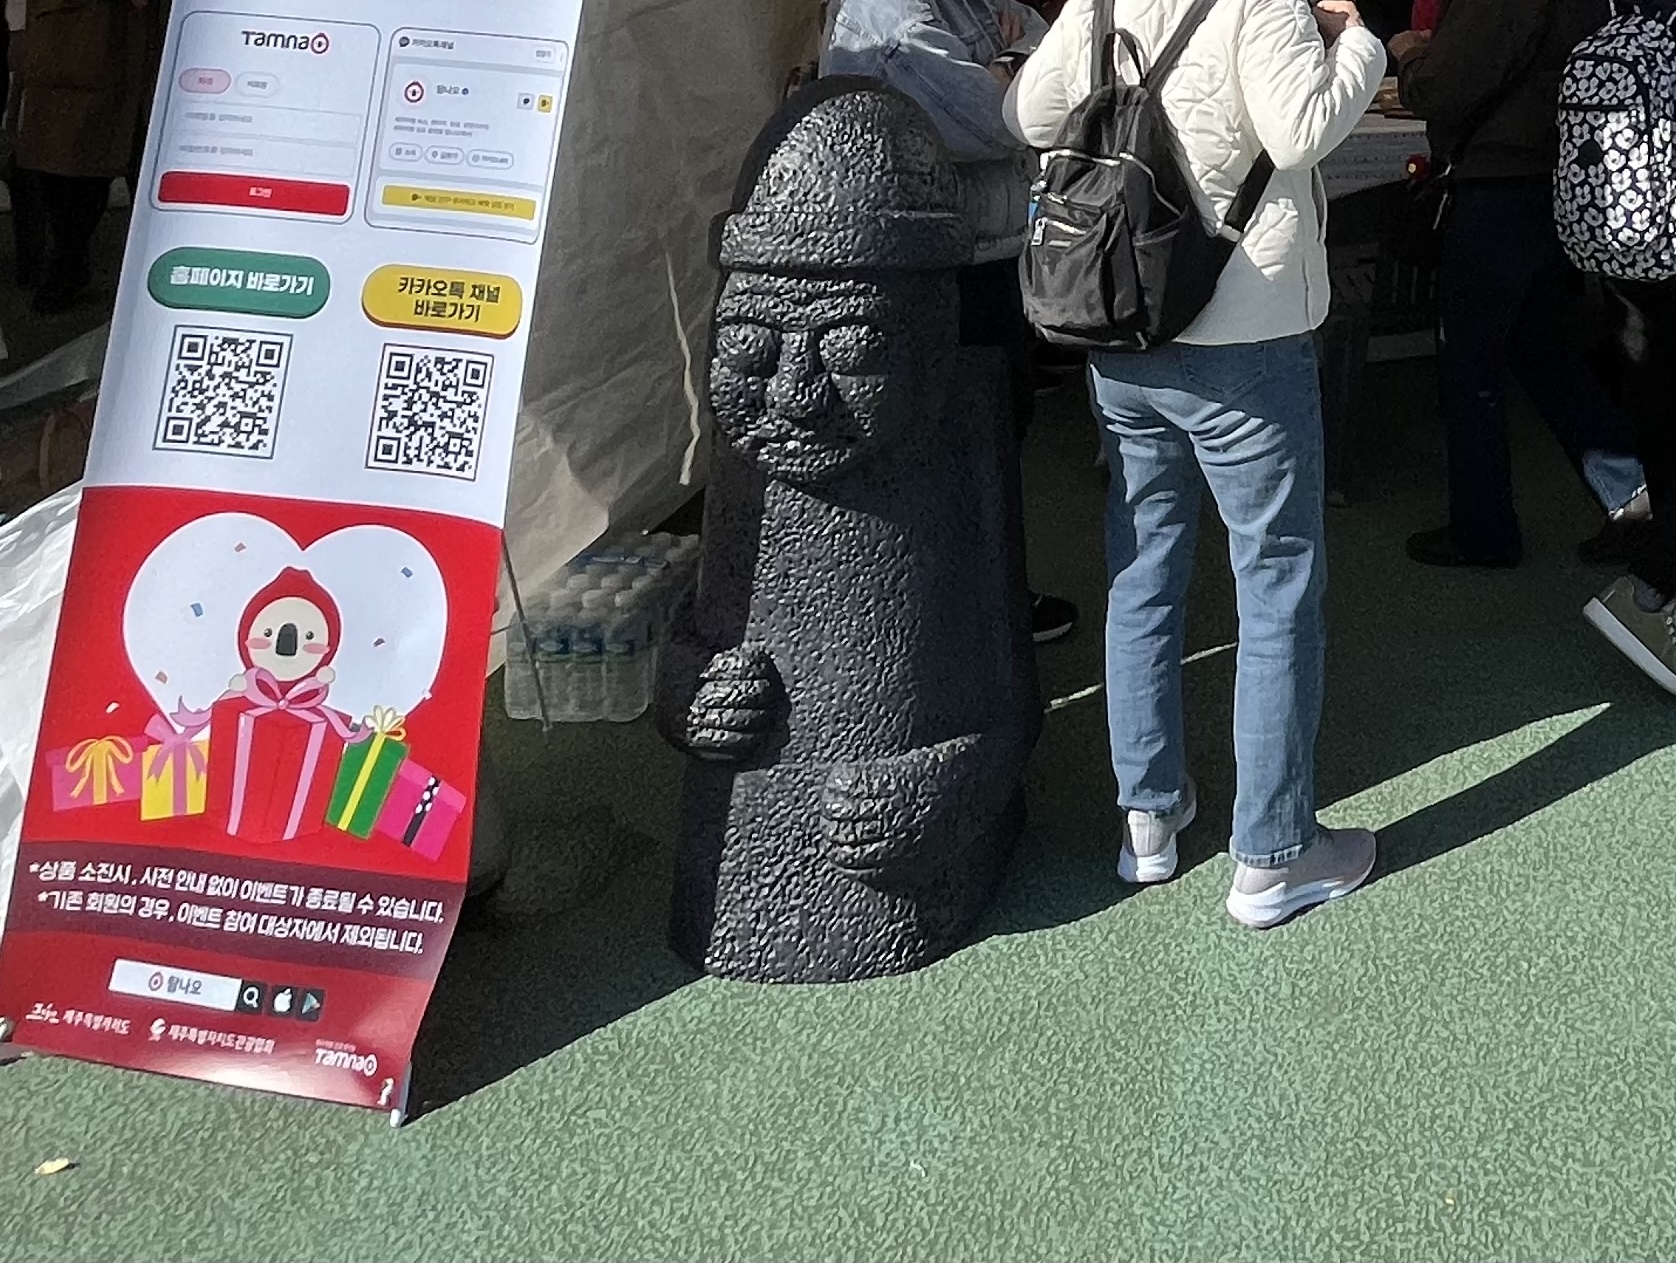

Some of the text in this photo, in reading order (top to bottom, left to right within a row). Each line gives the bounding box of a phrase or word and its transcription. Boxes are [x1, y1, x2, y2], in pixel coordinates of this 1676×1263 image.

[170, 265, 316, 296] 홈페이지 바로가기
[397, 276, 502, 304] 카카오톡 채널
[413, 300, 481, 323] 바로가기
[140, 867, 174, 888] 사전
[175, 870, 207, 893] 안내
[208, 875, 239, 899] 없이
[241, 880, 305, 907] 이벤트가
[305, 888, 357, 913] 종료될
[357, 893, 374, 915] 수
[376, 895, 445, 924] 있습니다.
[85, 892, 136, 915] 회원의
[177, 902, 223, 929] 이벤트
[223, 910, 258, 935] 참여
[258, 914, 341, 944] 대상자에서
[341, 922, 424, 955] 제외됩니다.
